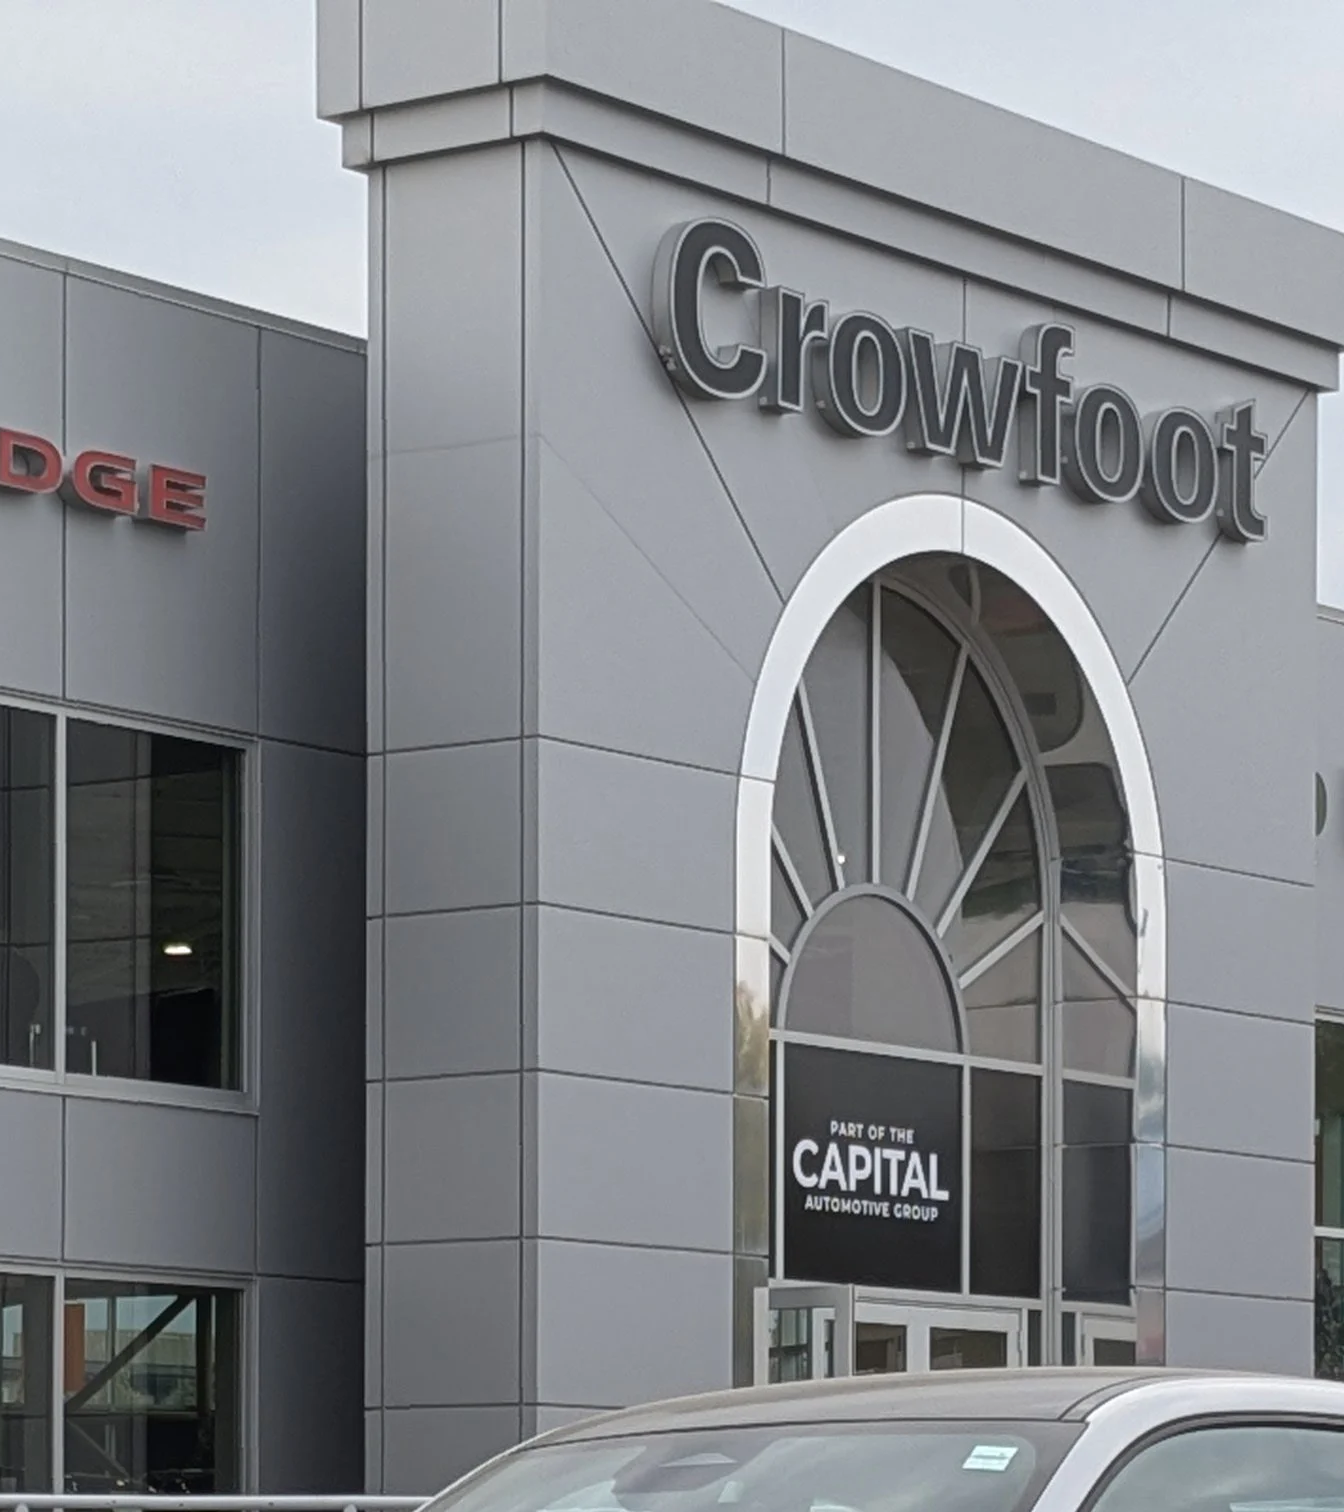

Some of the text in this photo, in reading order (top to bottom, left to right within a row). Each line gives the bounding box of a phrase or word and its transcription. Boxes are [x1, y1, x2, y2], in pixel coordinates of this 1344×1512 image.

[667, 215, 1269, 542] Crowfoot
[830, 1120, 915, 1145] PART OF THE
[792, 1138, 950, 1202] CAPITAL
[804, 1194, 939, 1222] AUTOMOTIVE GROUP
